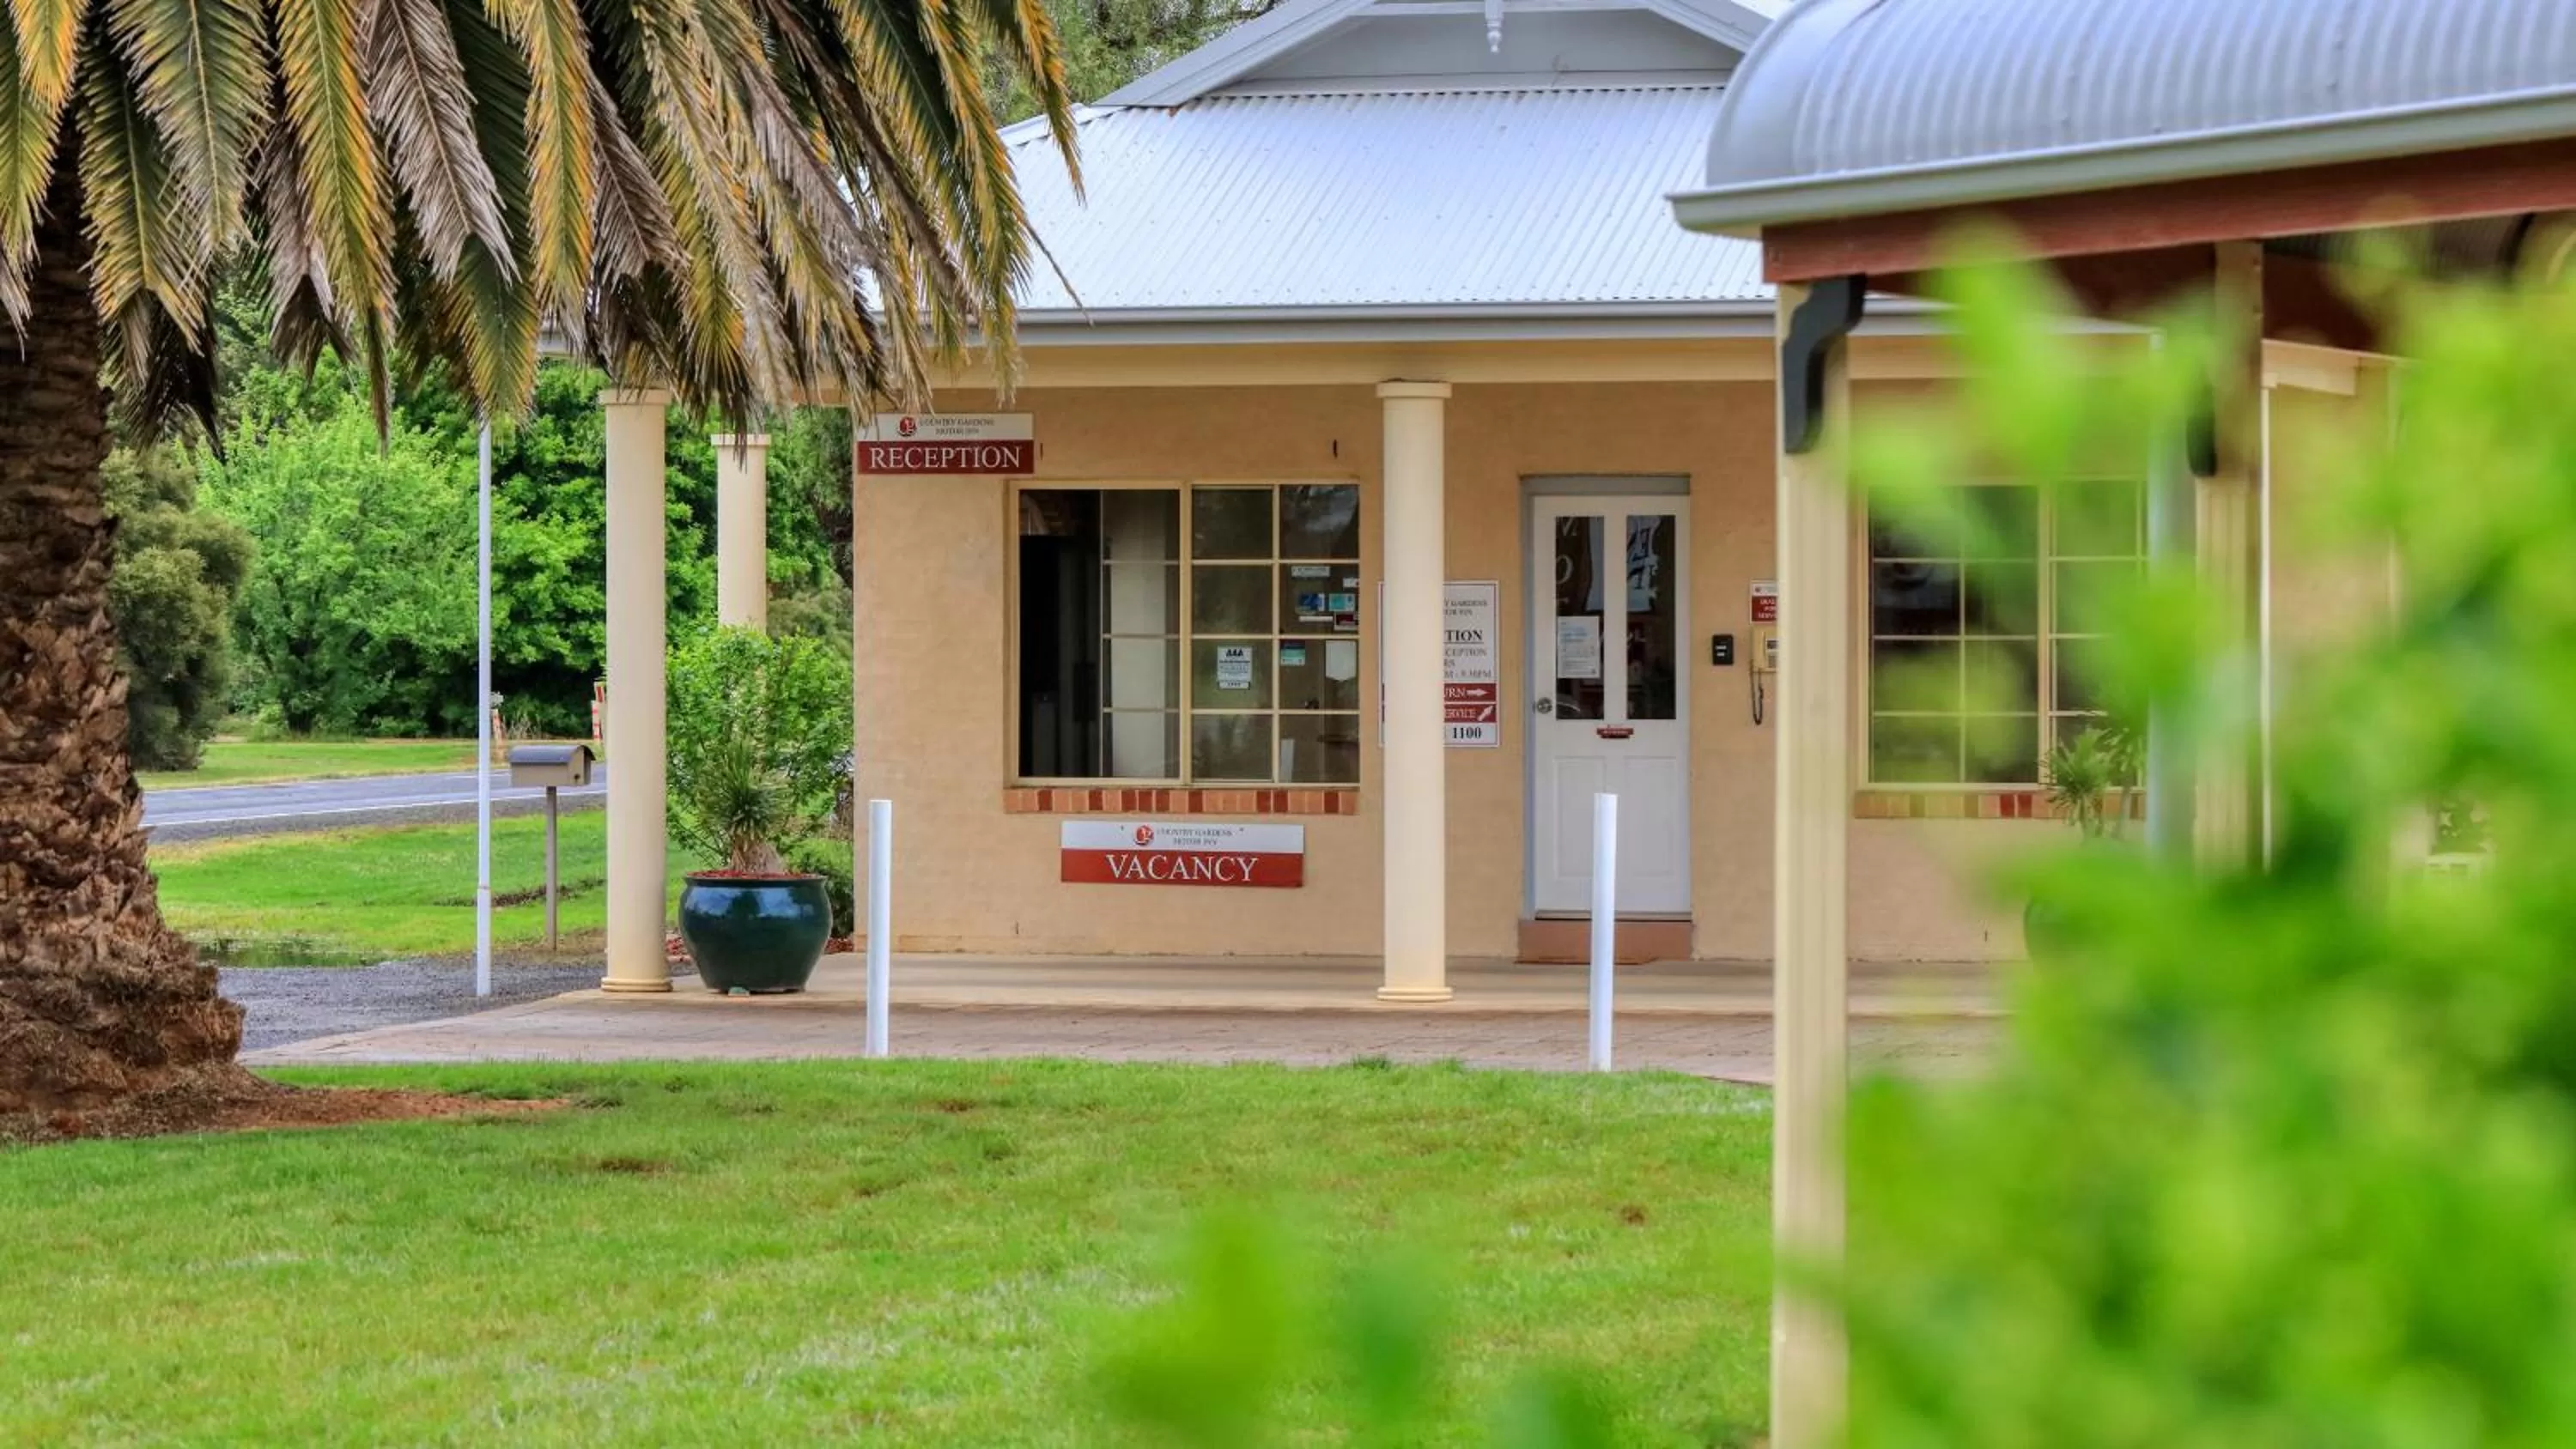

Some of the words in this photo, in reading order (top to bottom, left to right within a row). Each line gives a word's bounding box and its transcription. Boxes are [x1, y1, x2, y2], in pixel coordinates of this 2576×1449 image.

[869, 446, 1021, 469] RECEPTION
[1452, 727, 1482, 739] 1100
[1106, 854, 1259, 882] VACANCY
